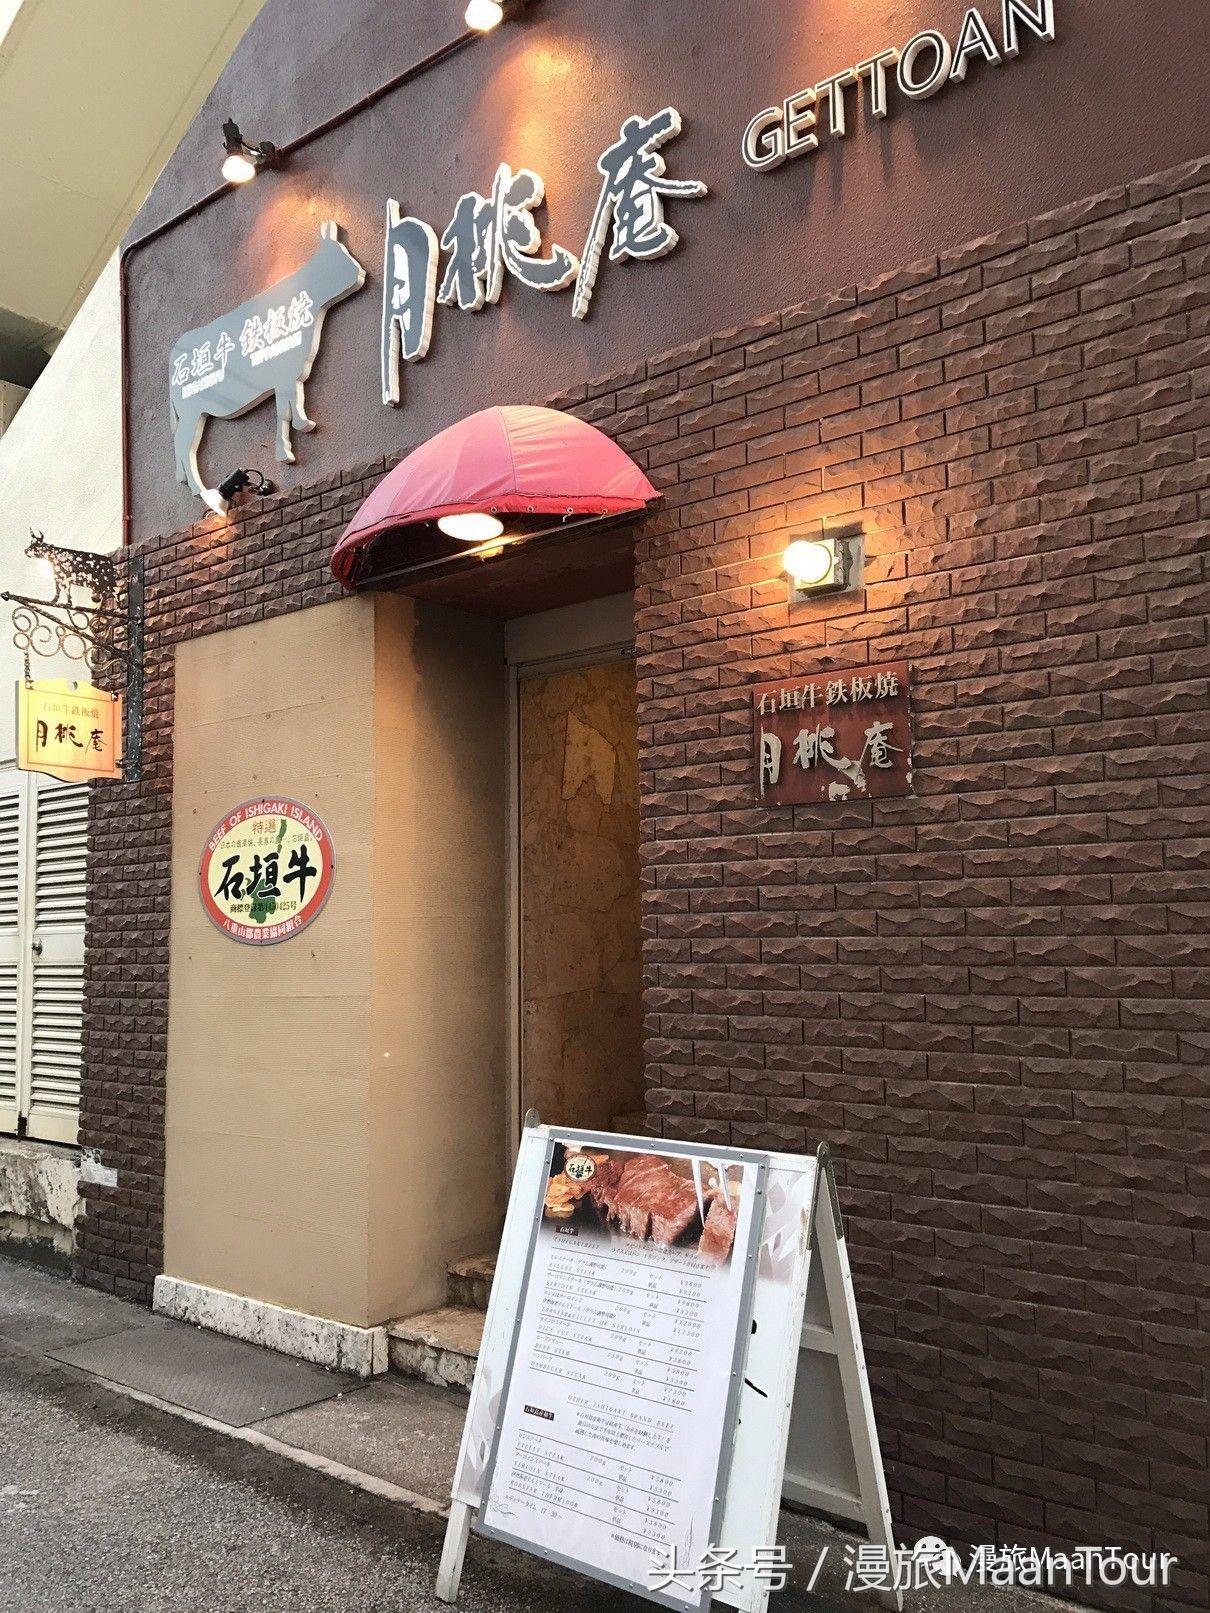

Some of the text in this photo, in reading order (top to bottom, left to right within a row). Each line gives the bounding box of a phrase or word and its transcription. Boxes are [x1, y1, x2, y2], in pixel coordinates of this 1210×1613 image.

[741, 0, 1056, 172] GETTOAN
[382, 106, 708, 406] 月桃庵
[172, 331, 236, 386] 石垣牛
[36, 717, 107, 755] 月桃庵
[208, 803, 323, 851] BEEF OF ISHIGAKI ISLAND
[214, 844, 318, 903] 石垣牛
